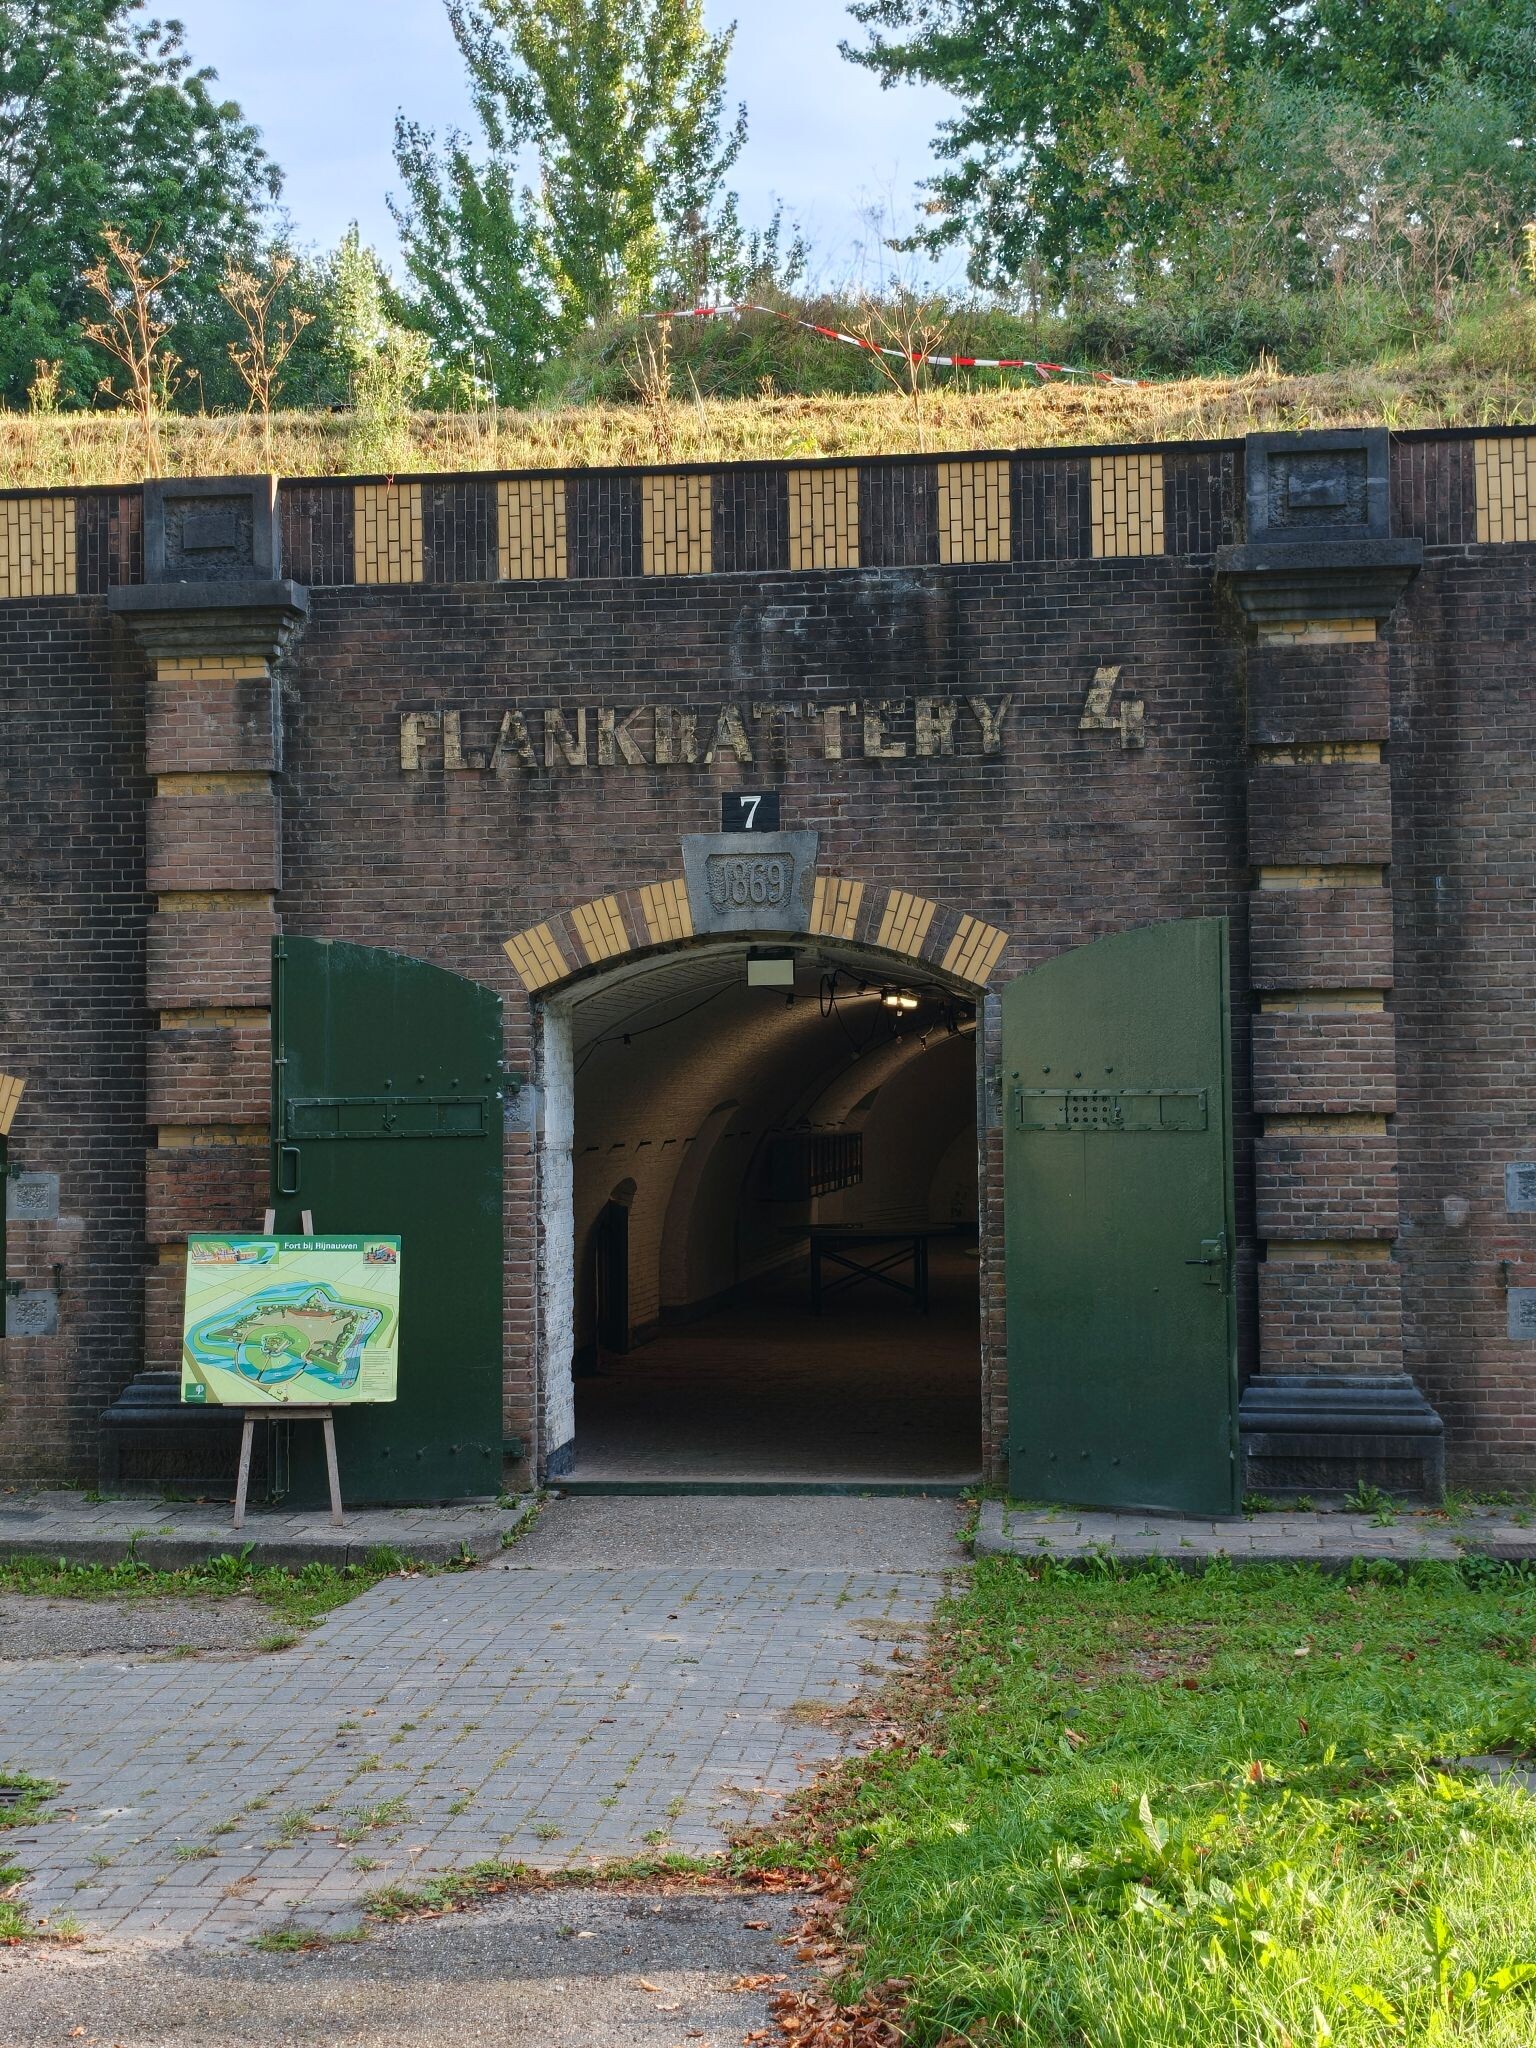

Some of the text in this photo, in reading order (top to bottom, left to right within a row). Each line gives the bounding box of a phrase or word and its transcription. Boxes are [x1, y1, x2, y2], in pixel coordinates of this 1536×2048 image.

[400, 665, 1150, 770] FLANKBATTERY 4
[739, 795, 762, 829] 7
[721, 858, 786, 904] 1869
[284, 1241, 358, 1251] Fort bij Rijnauwen
